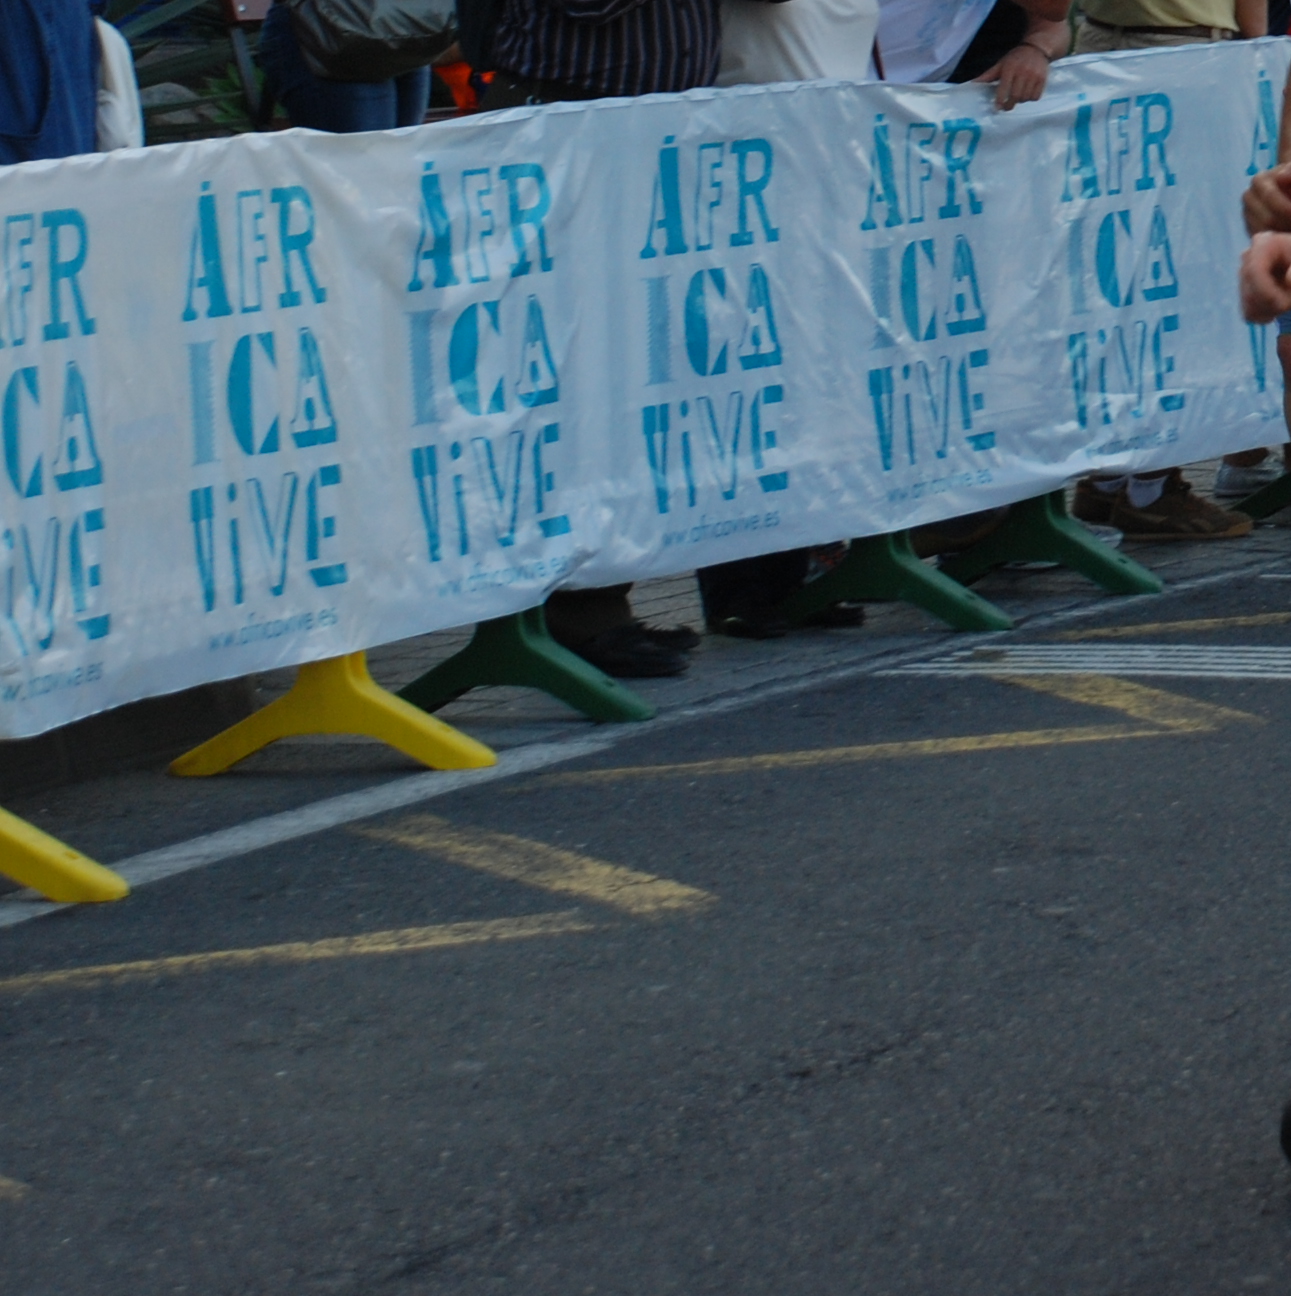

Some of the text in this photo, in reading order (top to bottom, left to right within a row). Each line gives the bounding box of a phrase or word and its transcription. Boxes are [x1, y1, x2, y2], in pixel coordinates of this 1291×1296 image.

[861, 233, 988, 351] ICA
[1067, 205, 1179, 316] ICA
[409, 294, 560, 427] ICA
[640, 263, 783, 386] ICA
[188, 326, 338, 467] ICA
